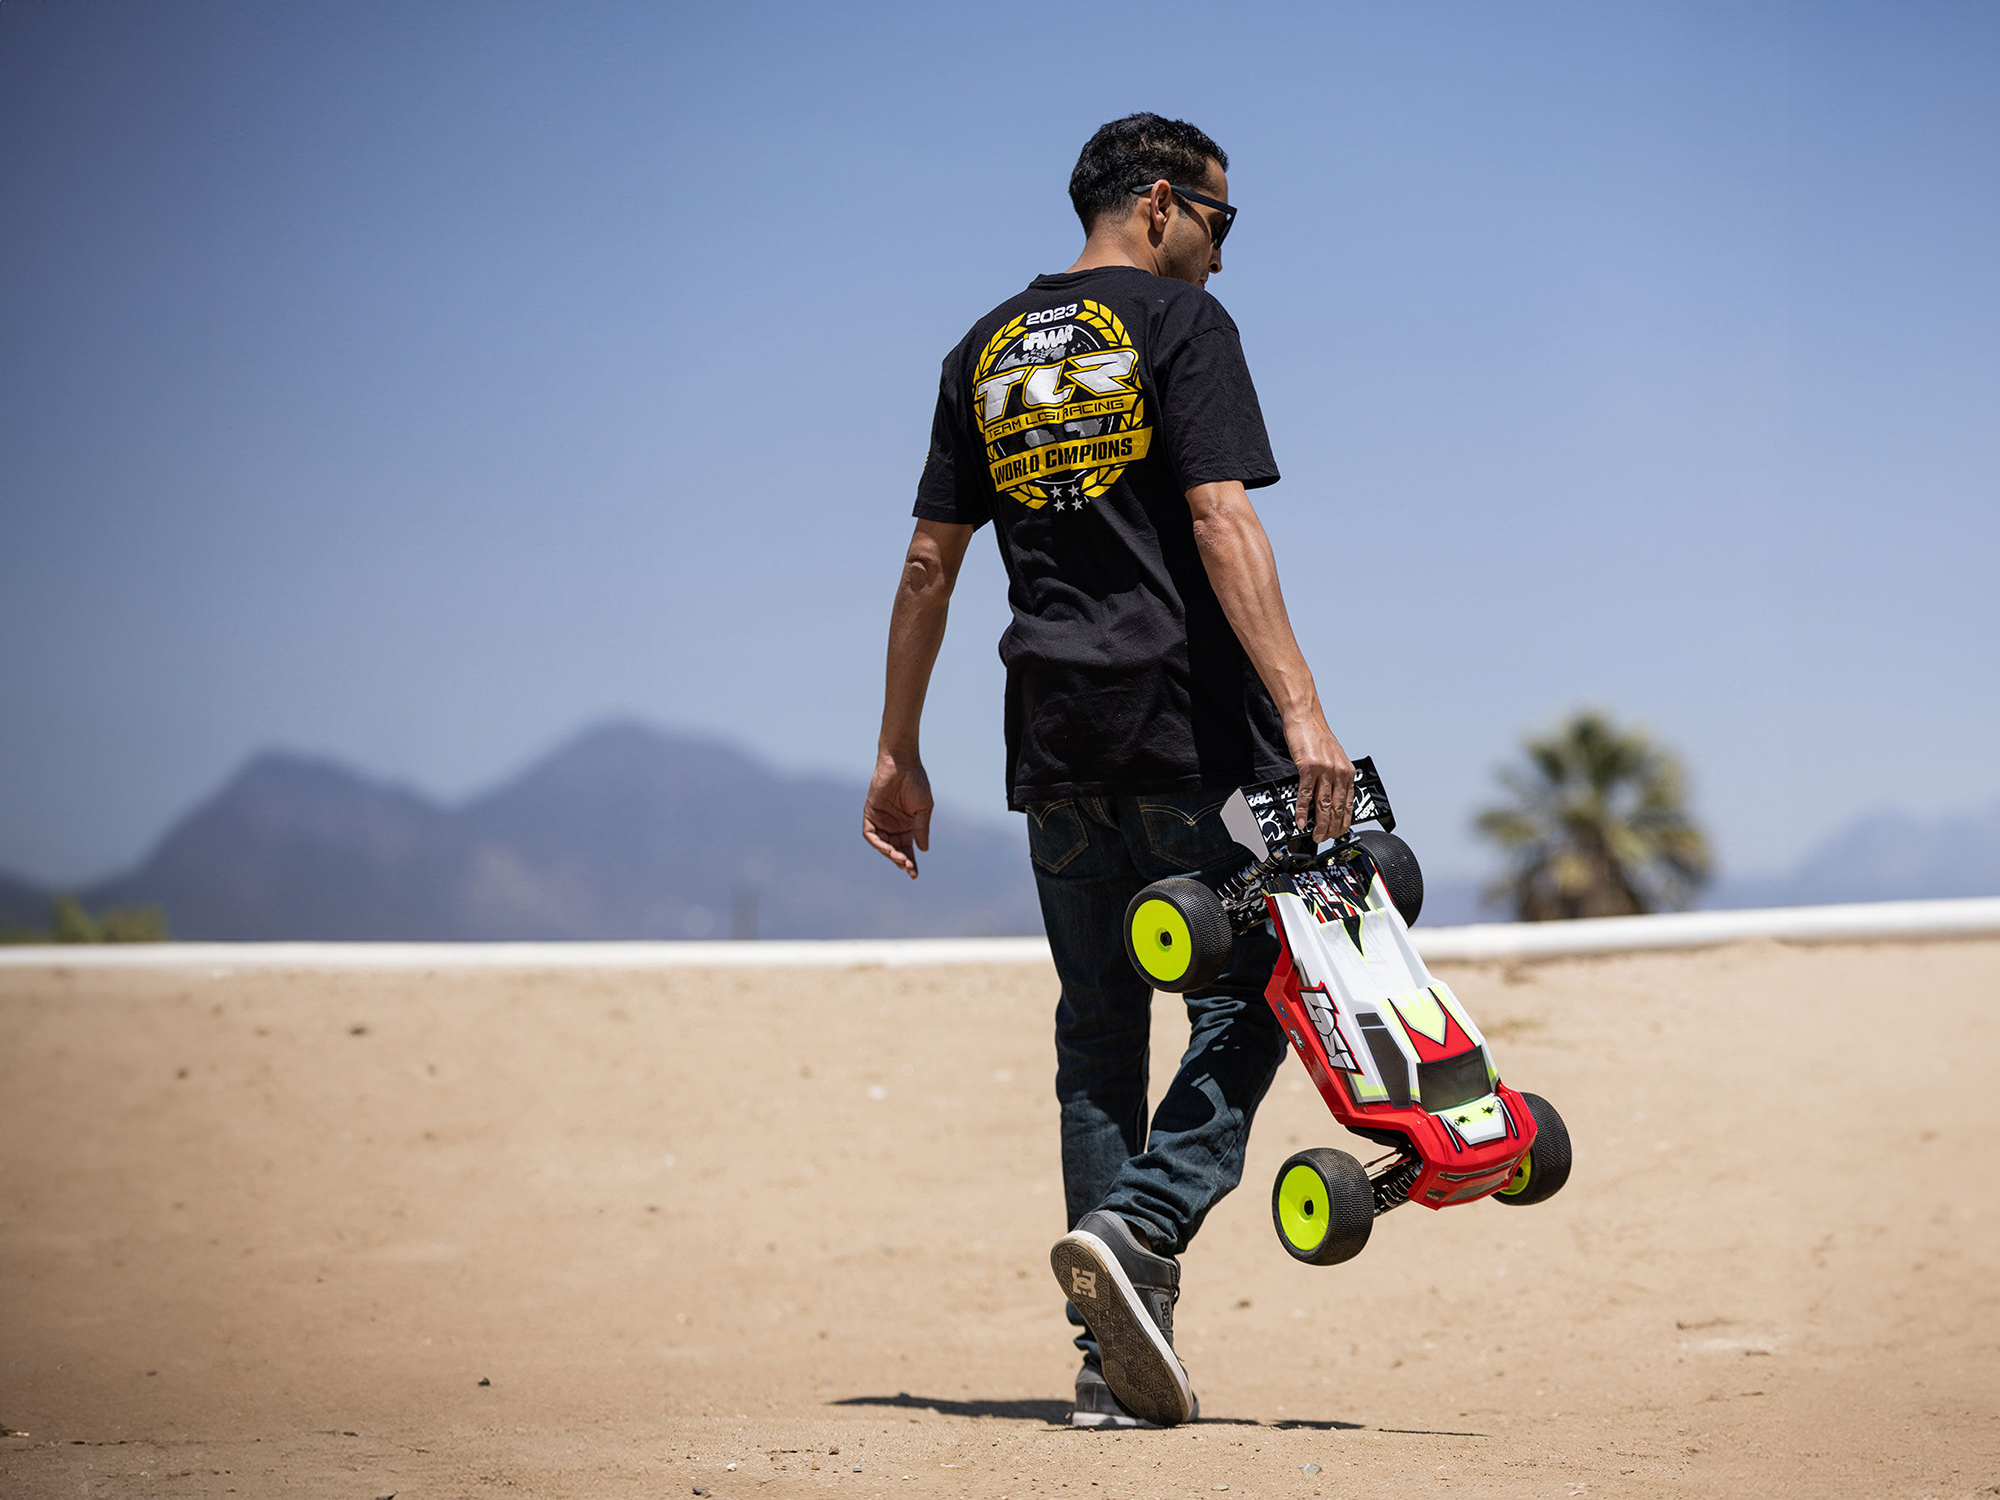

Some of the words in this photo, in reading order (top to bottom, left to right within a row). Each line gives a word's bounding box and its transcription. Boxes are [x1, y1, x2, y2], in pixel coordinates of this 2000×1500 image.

[1026, 303, 1078, 325] 2023
[975, 348, 1139, 425] TLR
[987, 419, 1022, 439] TEAM
[1062, 399, 1124, 420] RACING
[994, 454, 1040, 485] WORLD
